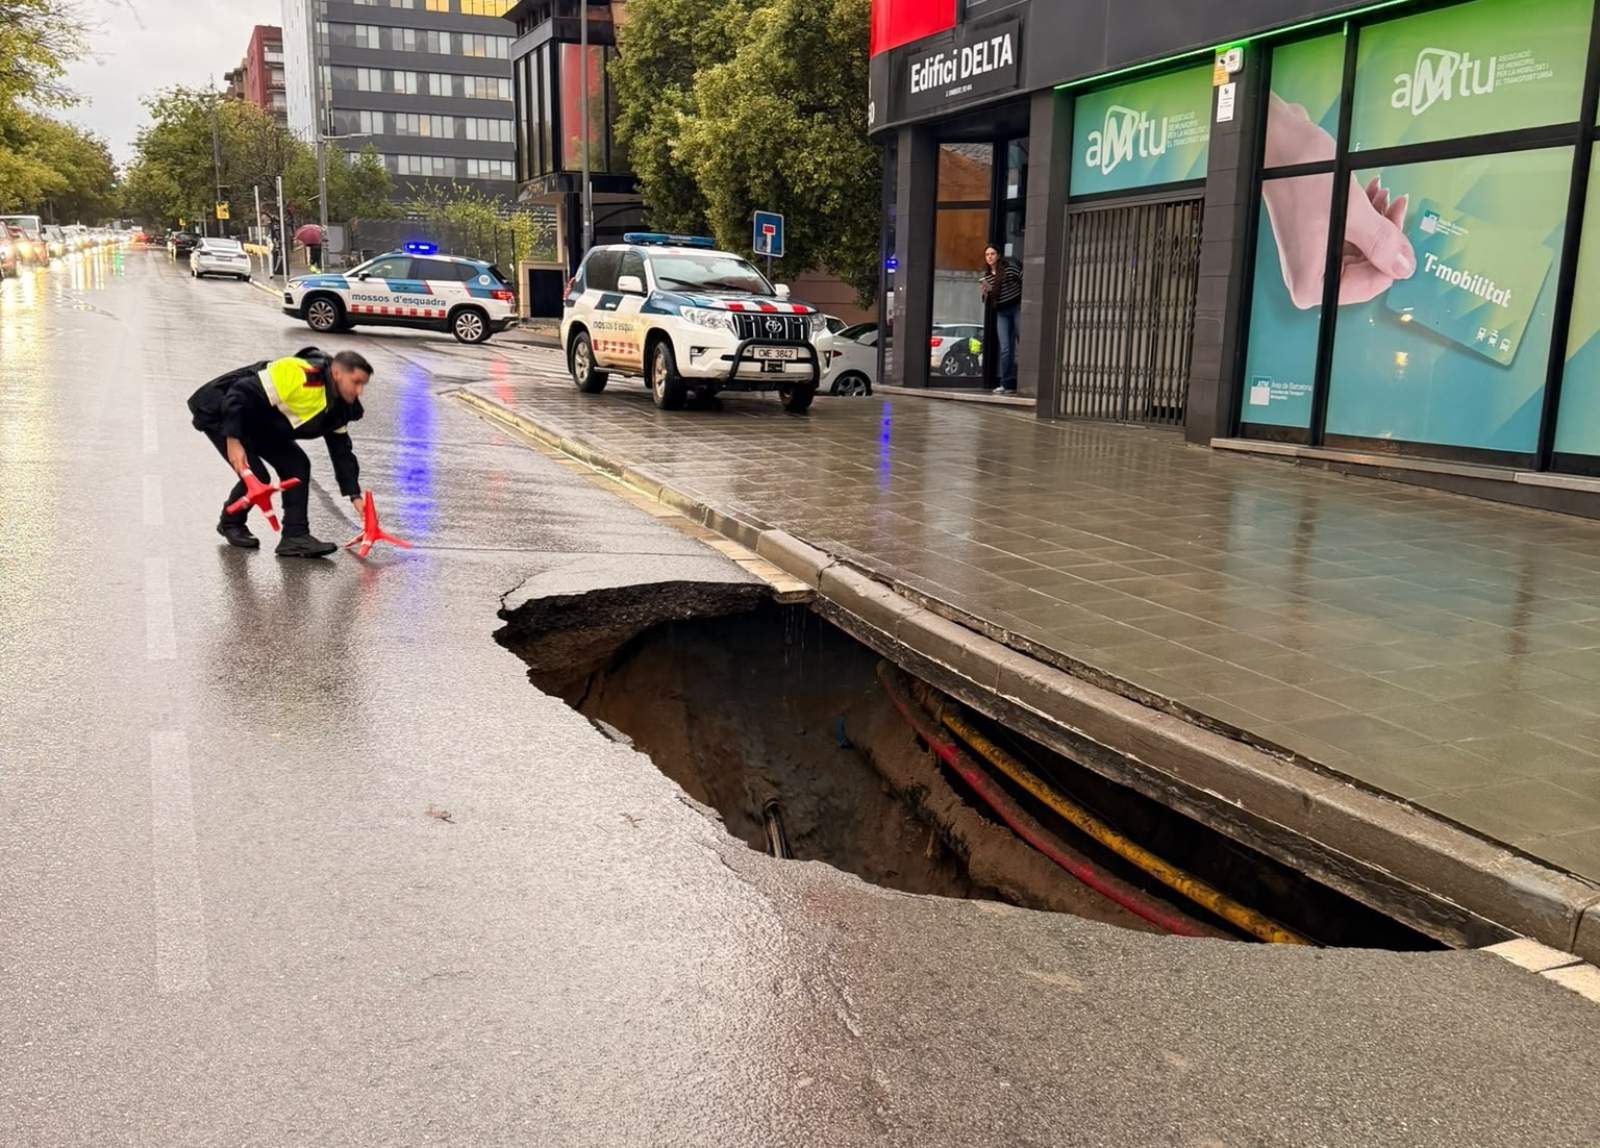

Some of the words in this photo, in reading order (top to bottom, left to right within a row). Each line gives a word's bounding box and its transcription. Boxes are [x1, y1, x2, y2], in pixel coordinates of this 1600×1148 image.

[911, 48, 958, 94] Edifici
[960, 33, 1014, 79] DELTA
[351, 293, 389, 303] mossos
[393, 295, 447, 307] d'esquadra
[1424, 252, 1512, 308] T-mobilitat
